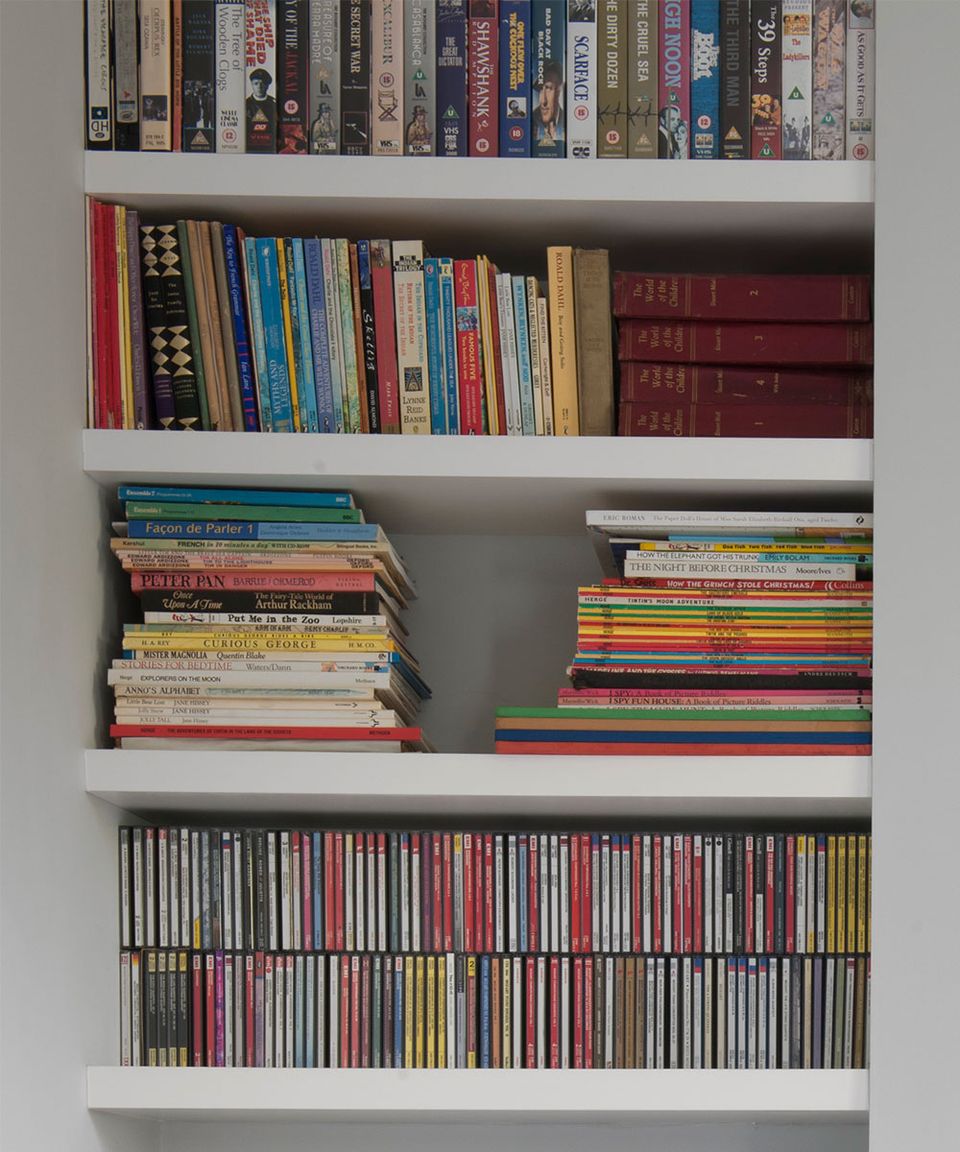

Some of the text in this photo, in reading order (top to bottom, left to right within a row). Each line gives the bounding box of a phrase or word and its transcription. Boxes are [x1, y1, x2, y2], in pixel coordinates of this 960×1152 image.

[232, 8, 243, 71] The Tree of
[246, 12, 257, 67] SHAME
[256, 26, 267, 64] DIED
[264, 17, 274, 48] SHIP
[350, 6, 361, 74] SECRET WAR
[445, 37, 455, 46] THE
[217, 7, 230, 91] Wooden Clogs
[285, 10, 298, 92] OF THE JACKAL
[312, 30, 321, 64] MADRE
[322, 47, 332, 63] OF
[442, 47, 458, 56] GREAT
[509, 12, 517, 90] THE NEST
[517, 21, 525, 83] ONE FLEW OVER
[546, 48, 552, 59] AT
[607, 15, 618, 88] DIRTY DOZEN
[637, 21, 648, 82] CRUEL SEA
[665, 33, 681, 88] NOON
[698, 33, 714, 78] Boot
[755, 19, 776, 83] 39 Steps
[438, 57, 463, 66] DICTATOR
[476, 21, 490, 118] SHAWSHANK
[574, 35, 589, 101] SCARFACE
[727, 30, 739, 107] THIRD MAN
[229, 269, 238, 287] French
[309, 243, 322, 305] ROALD DAHL
[555, 252, 563, 283] ROALD
[232, 288, 241, 316] Grammar
[644, 279, 655, 304] World
[749, 289, 758, 297] 2
[468, 332, 476, 362] FAMOUS
[638, 329, 648, 343] The
[241, 361, 251, 391] Ian Lane
[145, 523, 253, 535] Façon de Parler 1
[140, 574, 191, 588] PETER
[196, 575, 225, 588] PAN
[630, 562, 787, 573] THE NIGHT BEFORE CHRISTMAS
[173, 591, 193, 599] Once
[270, 592, 303, 601] Fairy-Tale
[326, 592, 334, 600] of
[736, 581, 761, 589] STOLE
[833, 581, 865, 589] Collins
[162, 599, 223, 610] Upon A Time
[255, 600, 332, 609] Arthur Rackham
[227, 614, 361, 624] Put Me in the Zoo Lopshire
[170, 651, 208, 659] MAGNOLIA
[216, 651, 245, 660] Quentin
[245, 652, 266, 660] Blake
[203, 640, 317, 649] CURIOUS GEORGE
[120, 660, 232, 670] STORIES FOR BEDTIME
[124, 686, 201, 695] ANNO'S ALPHABET
